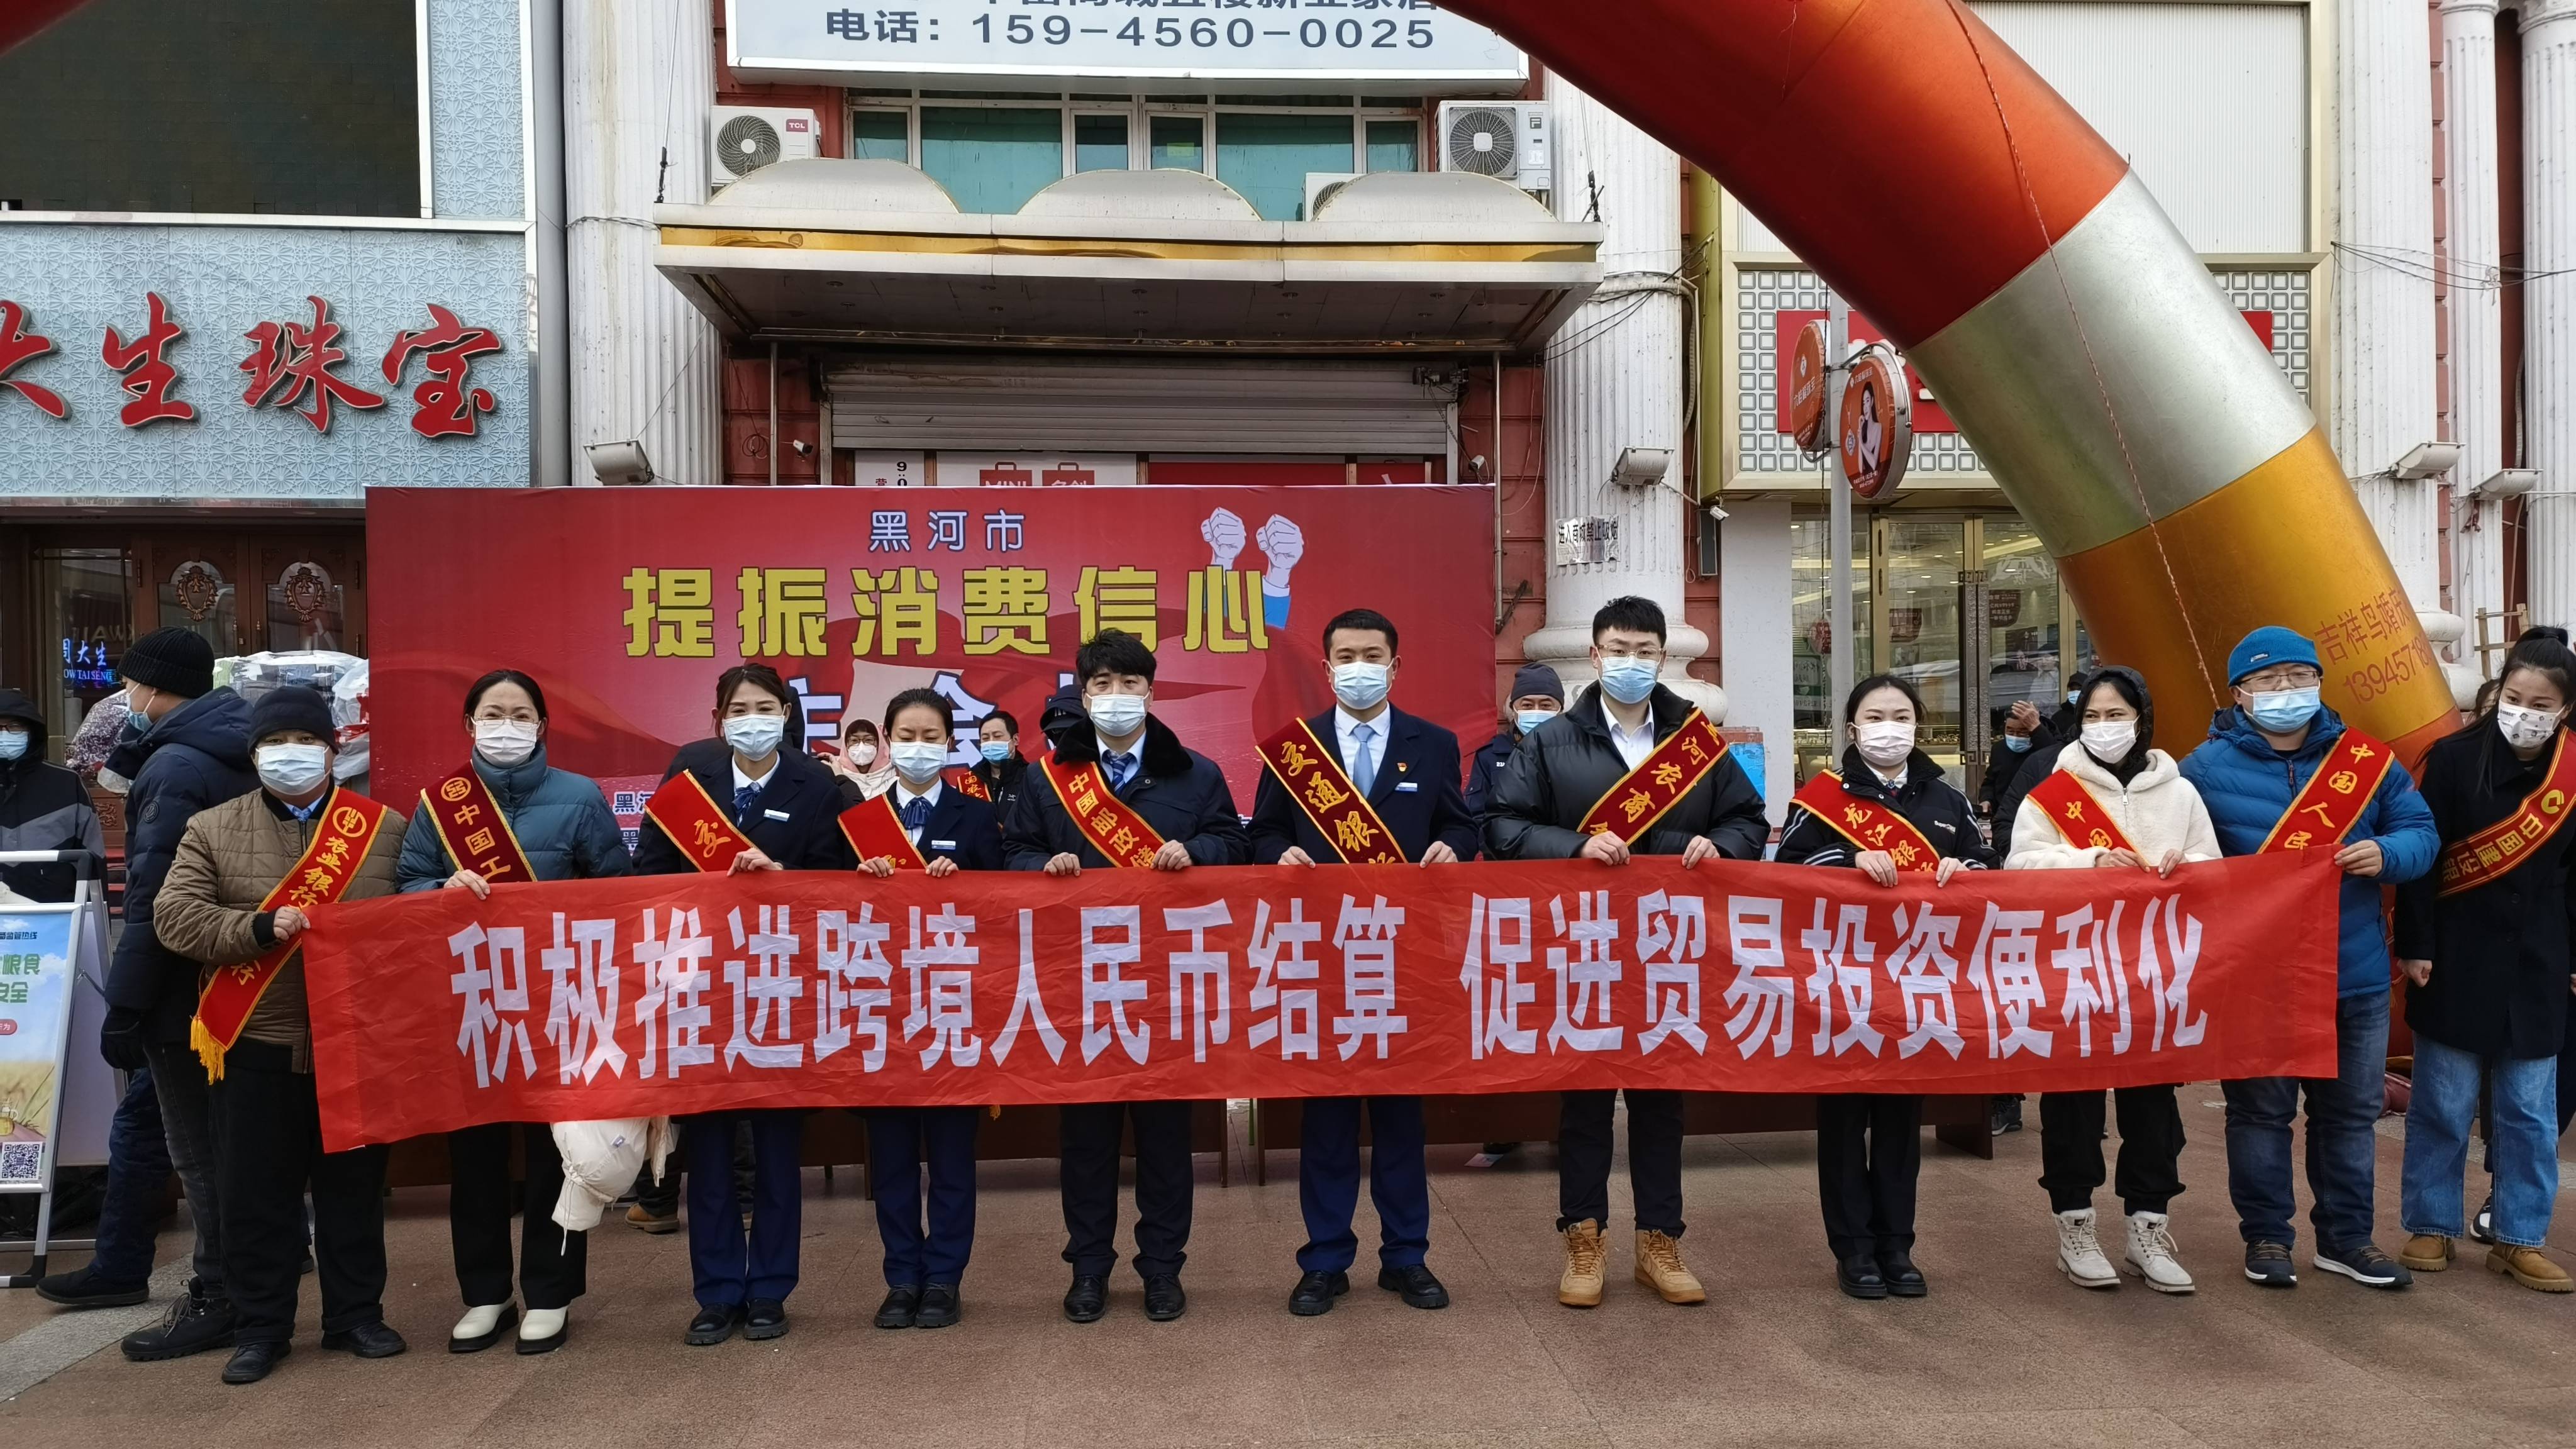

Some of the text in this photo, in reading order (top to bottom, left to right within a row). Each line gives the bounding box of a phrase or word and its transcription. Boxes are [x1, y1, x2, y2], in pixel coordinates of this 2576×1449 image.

[972, 13, 1434, 48] 159-4560-0025
[868, 508, 1026, 553] 黑河市
[623, 565, 1270, 658] 提振消费信心
[289, 836, 350, 909] 农业银行
[453, 804, 511, 881] 中国工
[447, 887, 2209, 1089] 积极推进跨境人民币结算 促进贸易投资便利化
